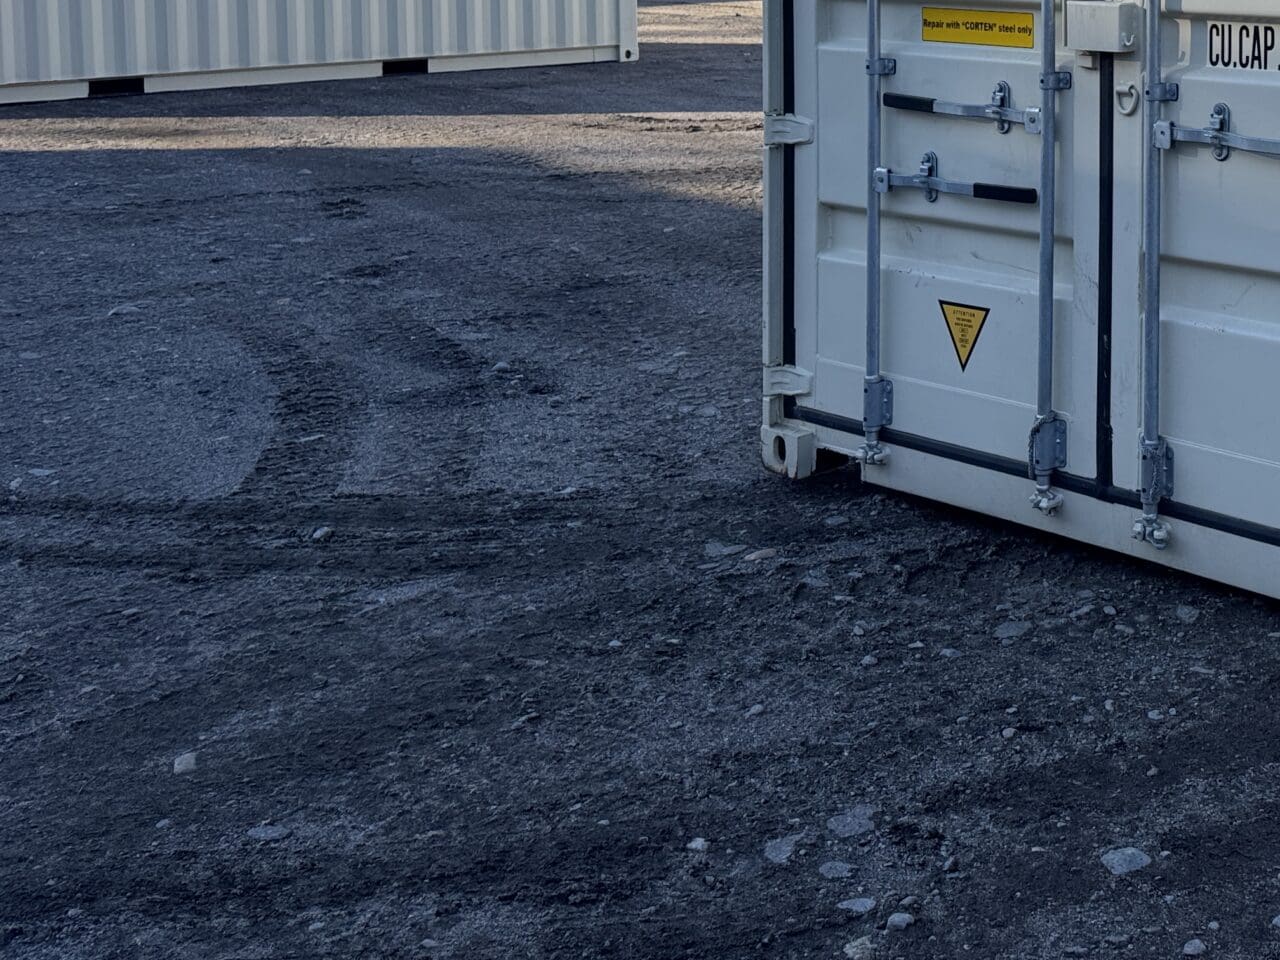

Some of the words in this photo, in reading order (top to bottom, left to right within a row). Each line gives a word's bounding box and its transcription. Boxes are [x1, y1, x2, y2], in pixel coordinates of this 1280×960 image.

[923, 19, 944, 30] Repair
[946, 20, 960, 29] with
[998, 24, 1016, 33] steel
[1017, 25, 1033, 36] only
